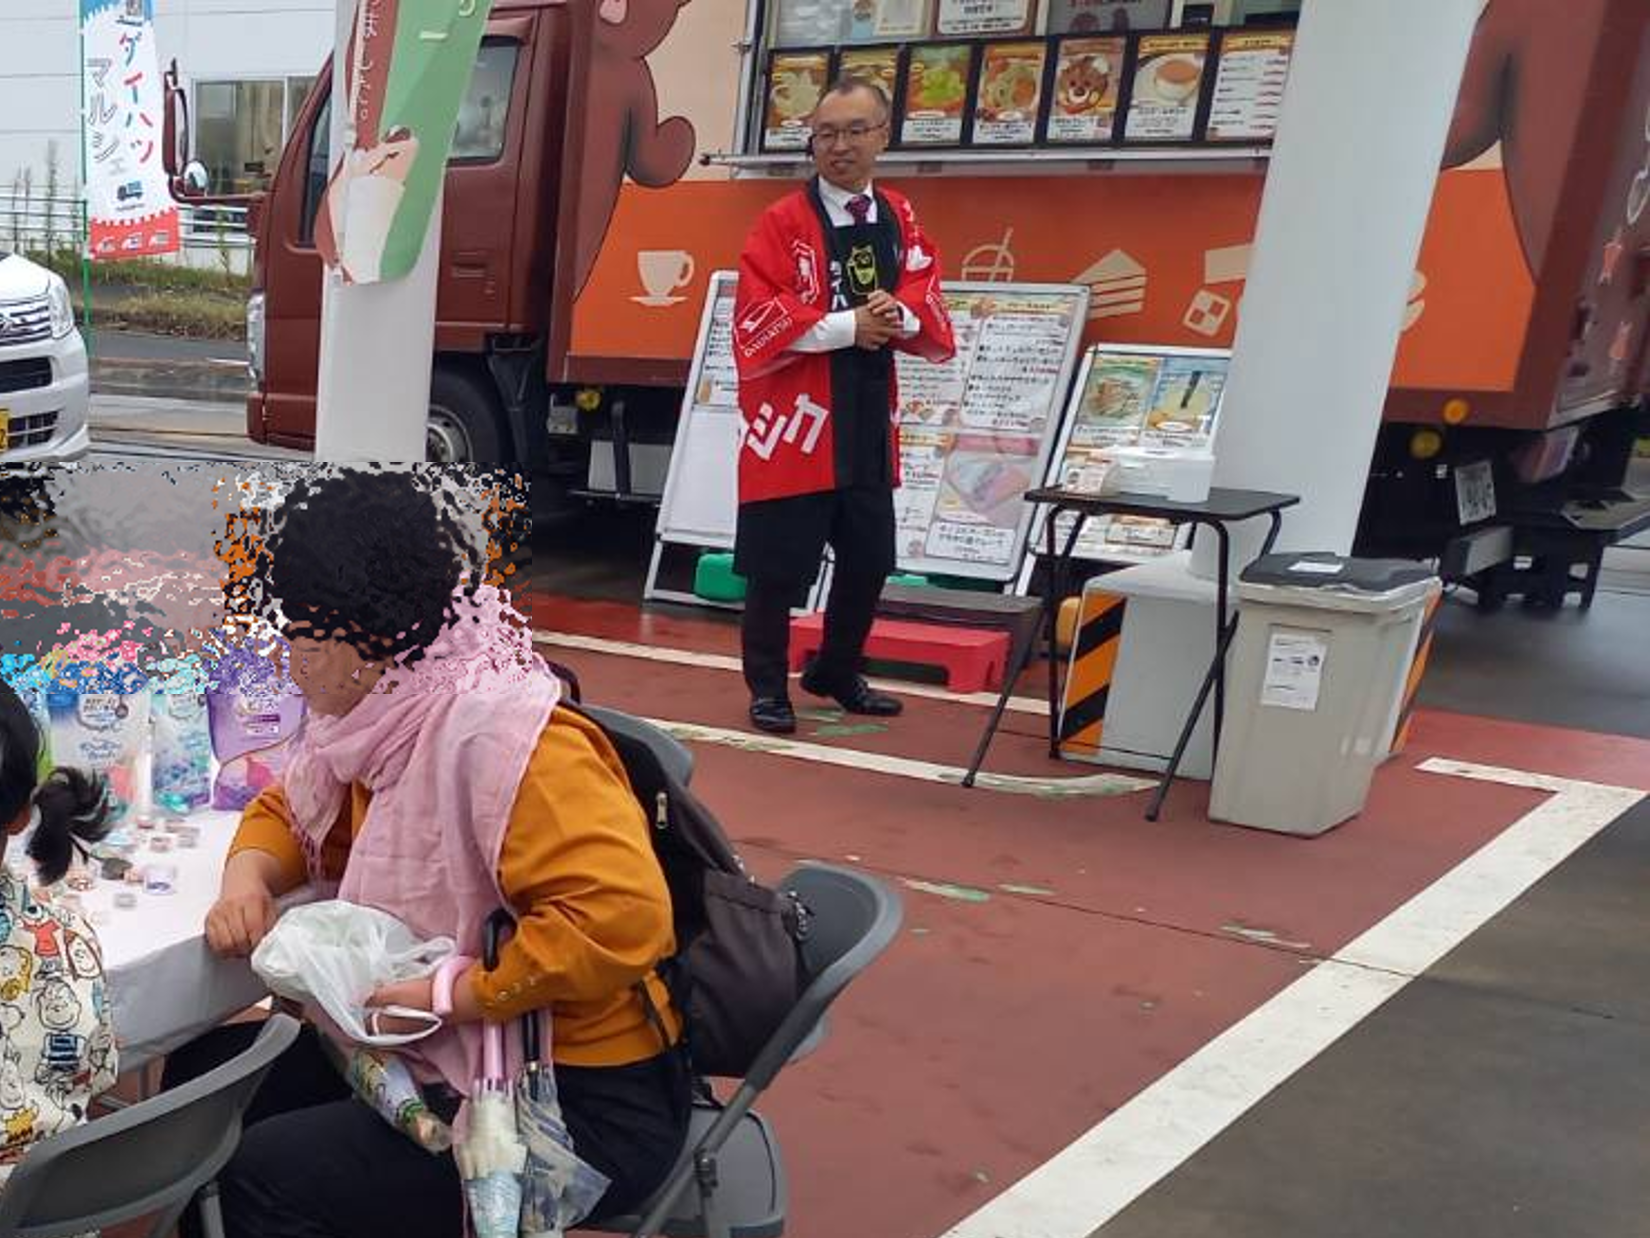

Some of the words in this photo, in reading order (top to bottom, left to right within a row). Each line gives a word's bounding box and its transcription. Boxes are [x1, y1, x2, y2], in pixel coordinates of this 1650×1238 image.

[87, 57, 126, 176] マルシェ
[119, 31, 154, 164] ダイハツ
